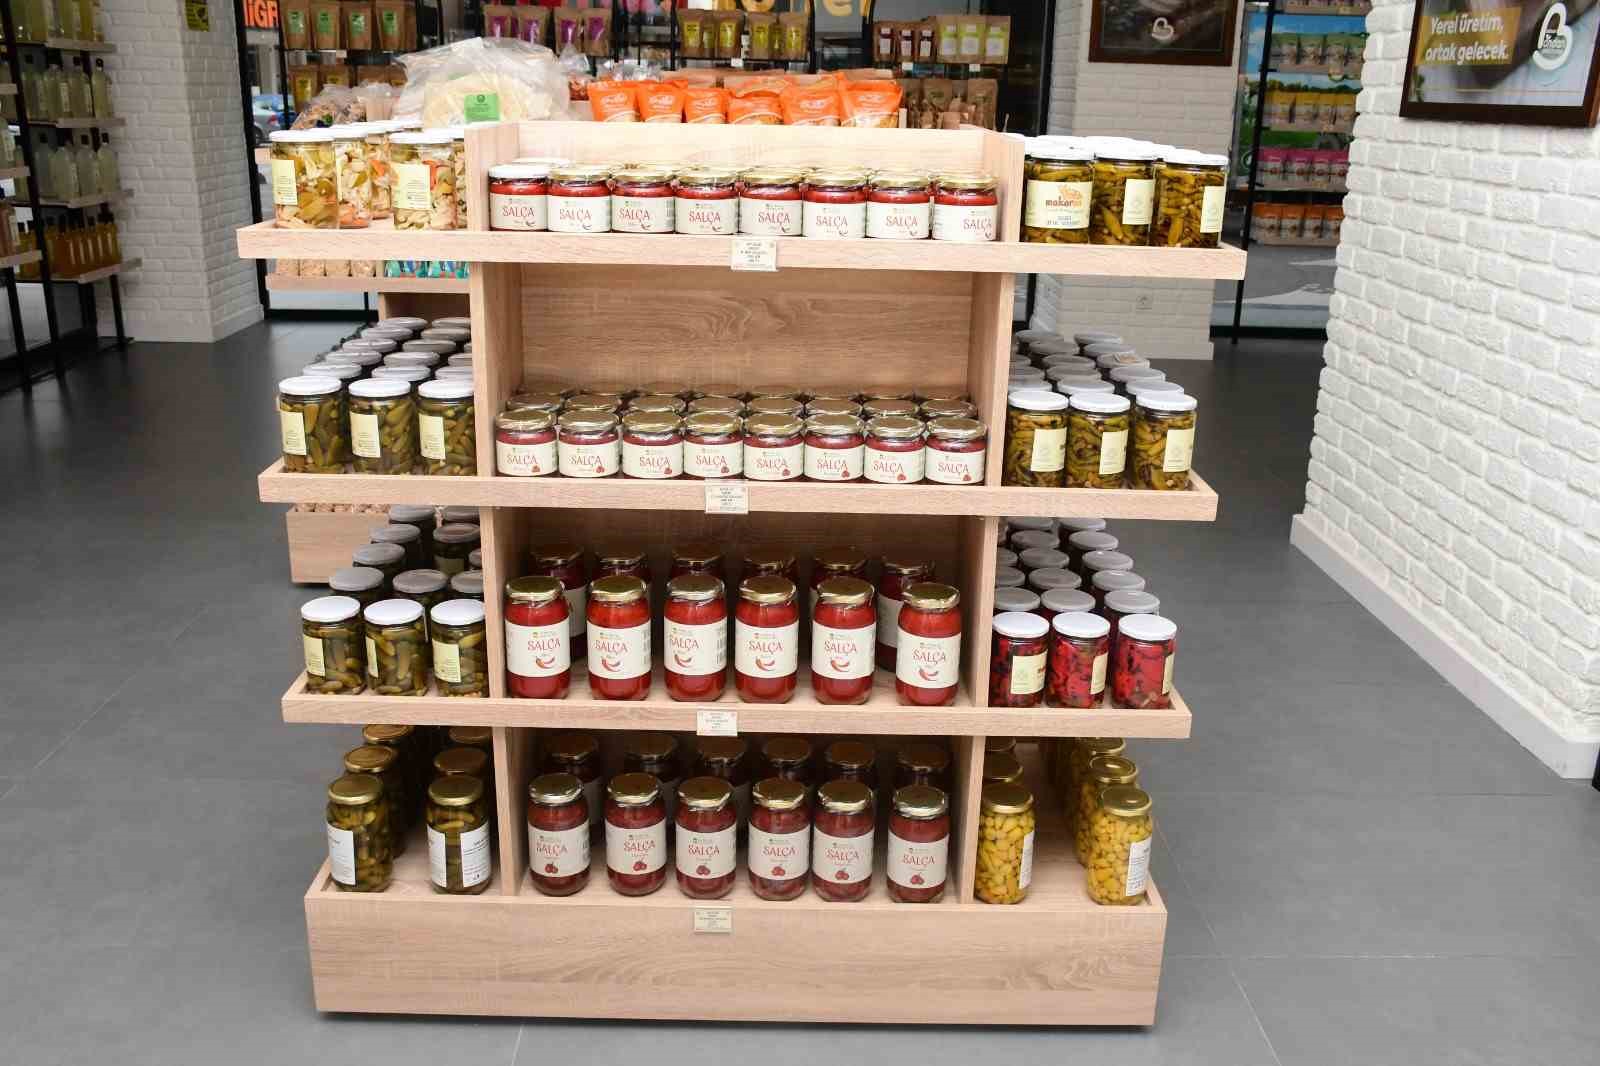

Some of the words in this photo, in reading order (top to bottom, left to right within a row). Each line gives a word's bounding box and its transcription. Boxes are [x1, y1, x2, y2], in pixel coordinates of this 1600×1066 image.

[1431, 16, 1458, 34] Yerel
[1459, 13, 1504, 33] üretim,
[1425, 43, 1457, 61] ortak
[1457, 41, 1510, 66] gelecek.
[502, 205, 535, 219] SALÇA
[559, 208, 592, 222] SALÇA
[619, 208, 650, 223] SALÇA
[689, 211, 721, 225] SALÇA
[758, 211, 790, 226] SALÇA
[816, 215, 848, 228] SALÇA
[886, 215, 918, 229] SALÇA
[963, 218, 992, 231] SALÇA
[506, 454, 538, 467] SALÇA
[571, 455, 602, 467] SALÇA
[639, 456, 671, 469] SALÇA
[695, 455, 727, 468] SALÇA
[756, 458, 788, 471] SALÇA
[817, 458, 848, 471] SALÇA
[873, 460, 904, 474] SALÇA
[938, 463, 969, 476] SALÇA
[528, 638, 561, 653] SALÇA
[594, 639, 628, 655] SALÇA
[669, 637, 699, 652] SALÇA
[748, 640, 783, 655] SALÇA
[824, 639, 857, 655] SALÇA
[912, 649, 946, 666] SALÇA
[536, 842, 568, 857] SALÇA
[623, 840, 656, 854] SALÇA
[688, 844, 720, 858] SALÇA
[763, 846, 796, 859] SALÇA
[826, 848, 860, 863] SALÇA
[903, 854, 935, 868] SALÇA
